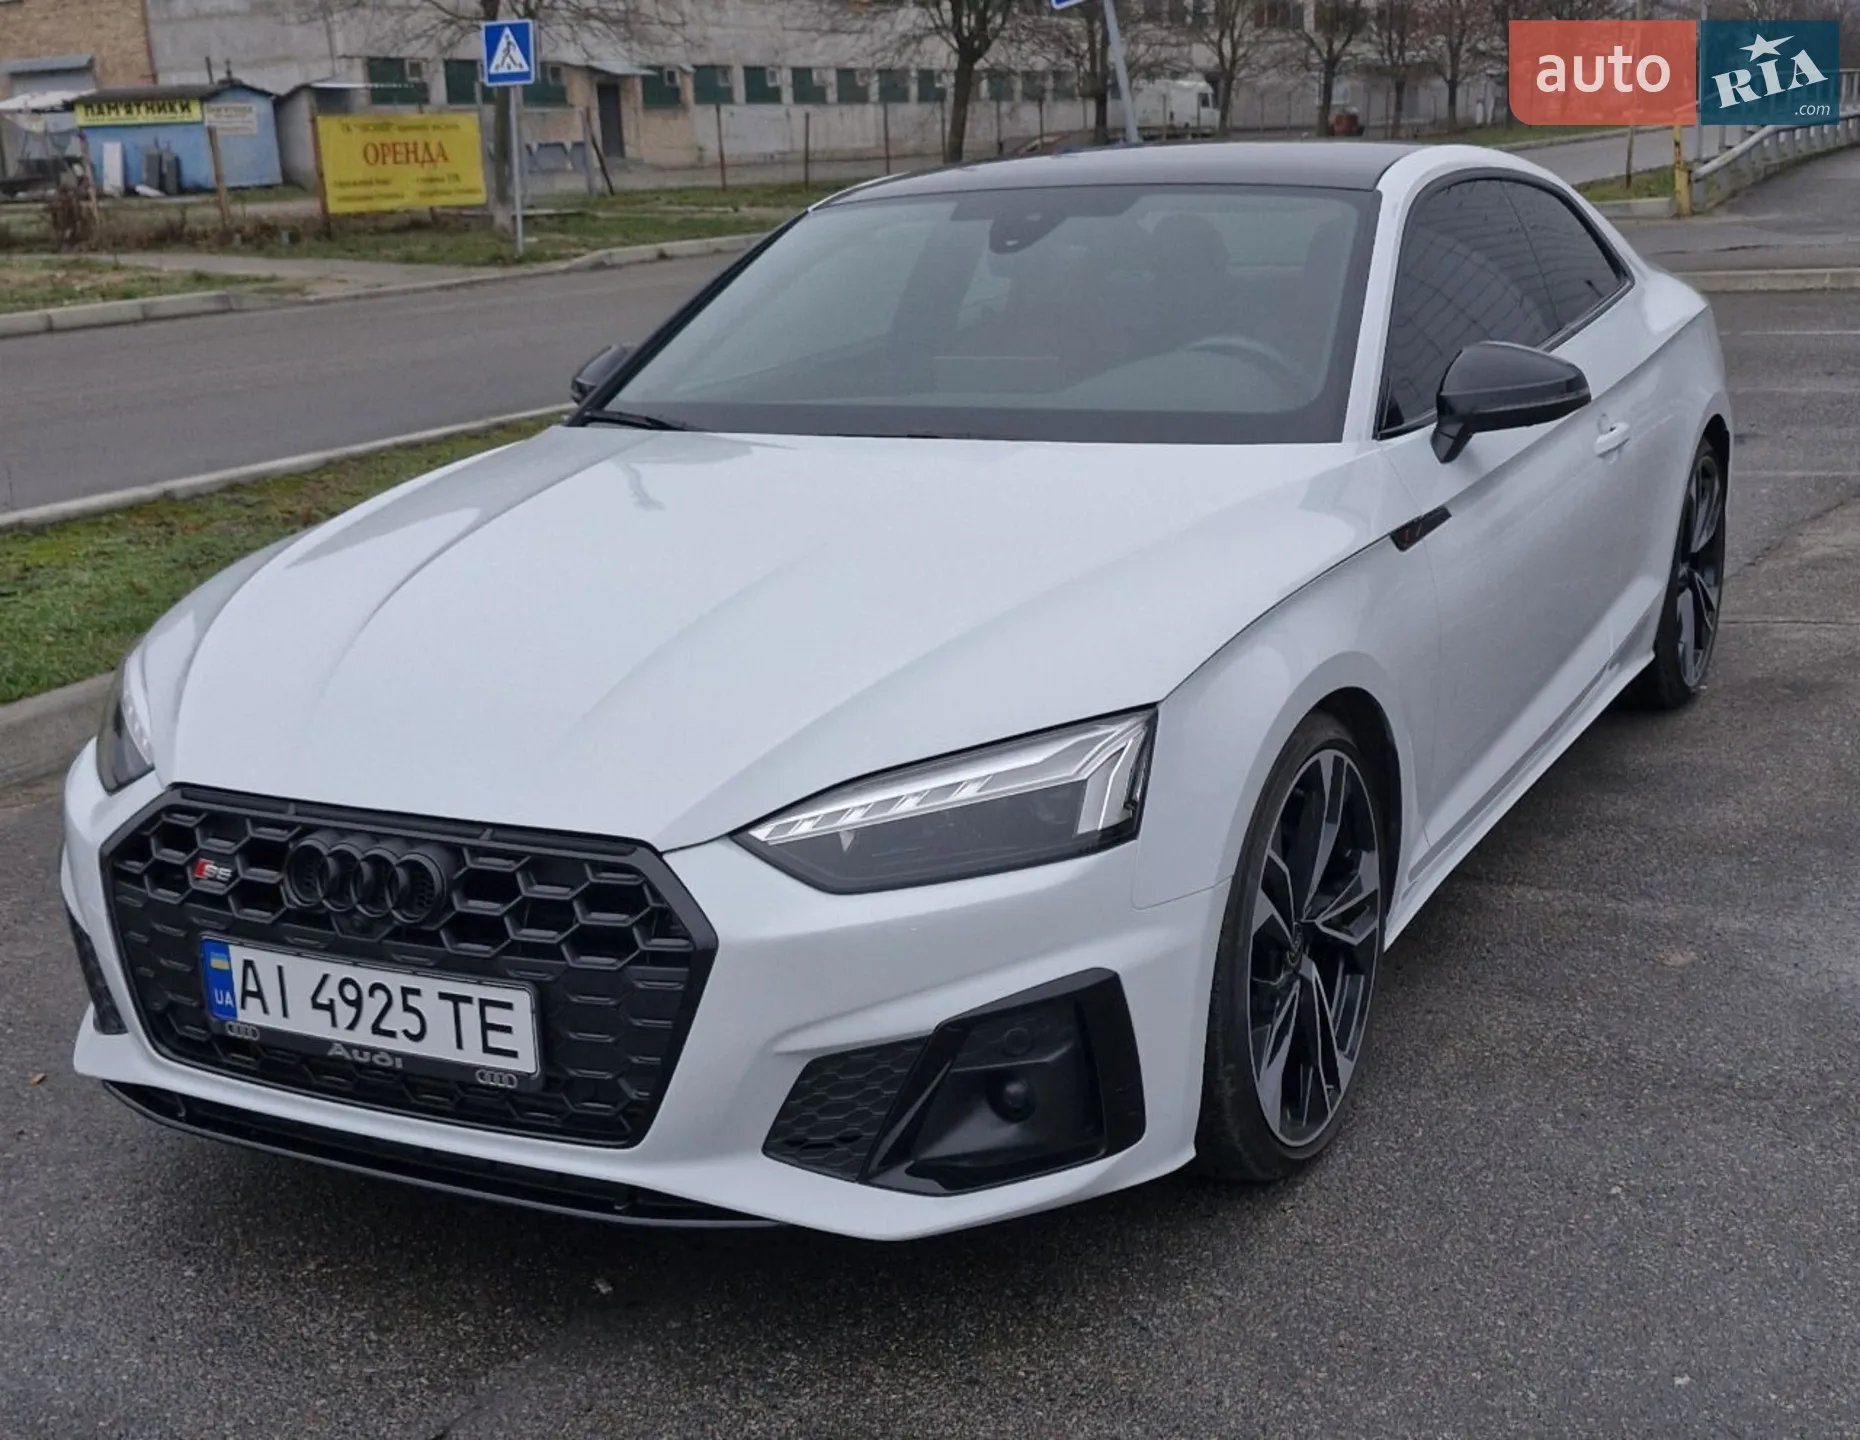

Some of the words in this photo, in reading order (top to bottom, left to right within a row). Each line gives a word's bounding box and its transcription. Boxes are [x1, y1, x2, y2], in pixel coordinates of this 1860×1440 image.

[363, 141, 450, 168] ОРЕНДА
[214, 987, 235, 1009] UA
[240, 958, 290, 1020] AI
[310, 973, 427, 1042] 4925
[437, 991, 520, 1060] TE
[327, 1042, 404, 1069] Audi
